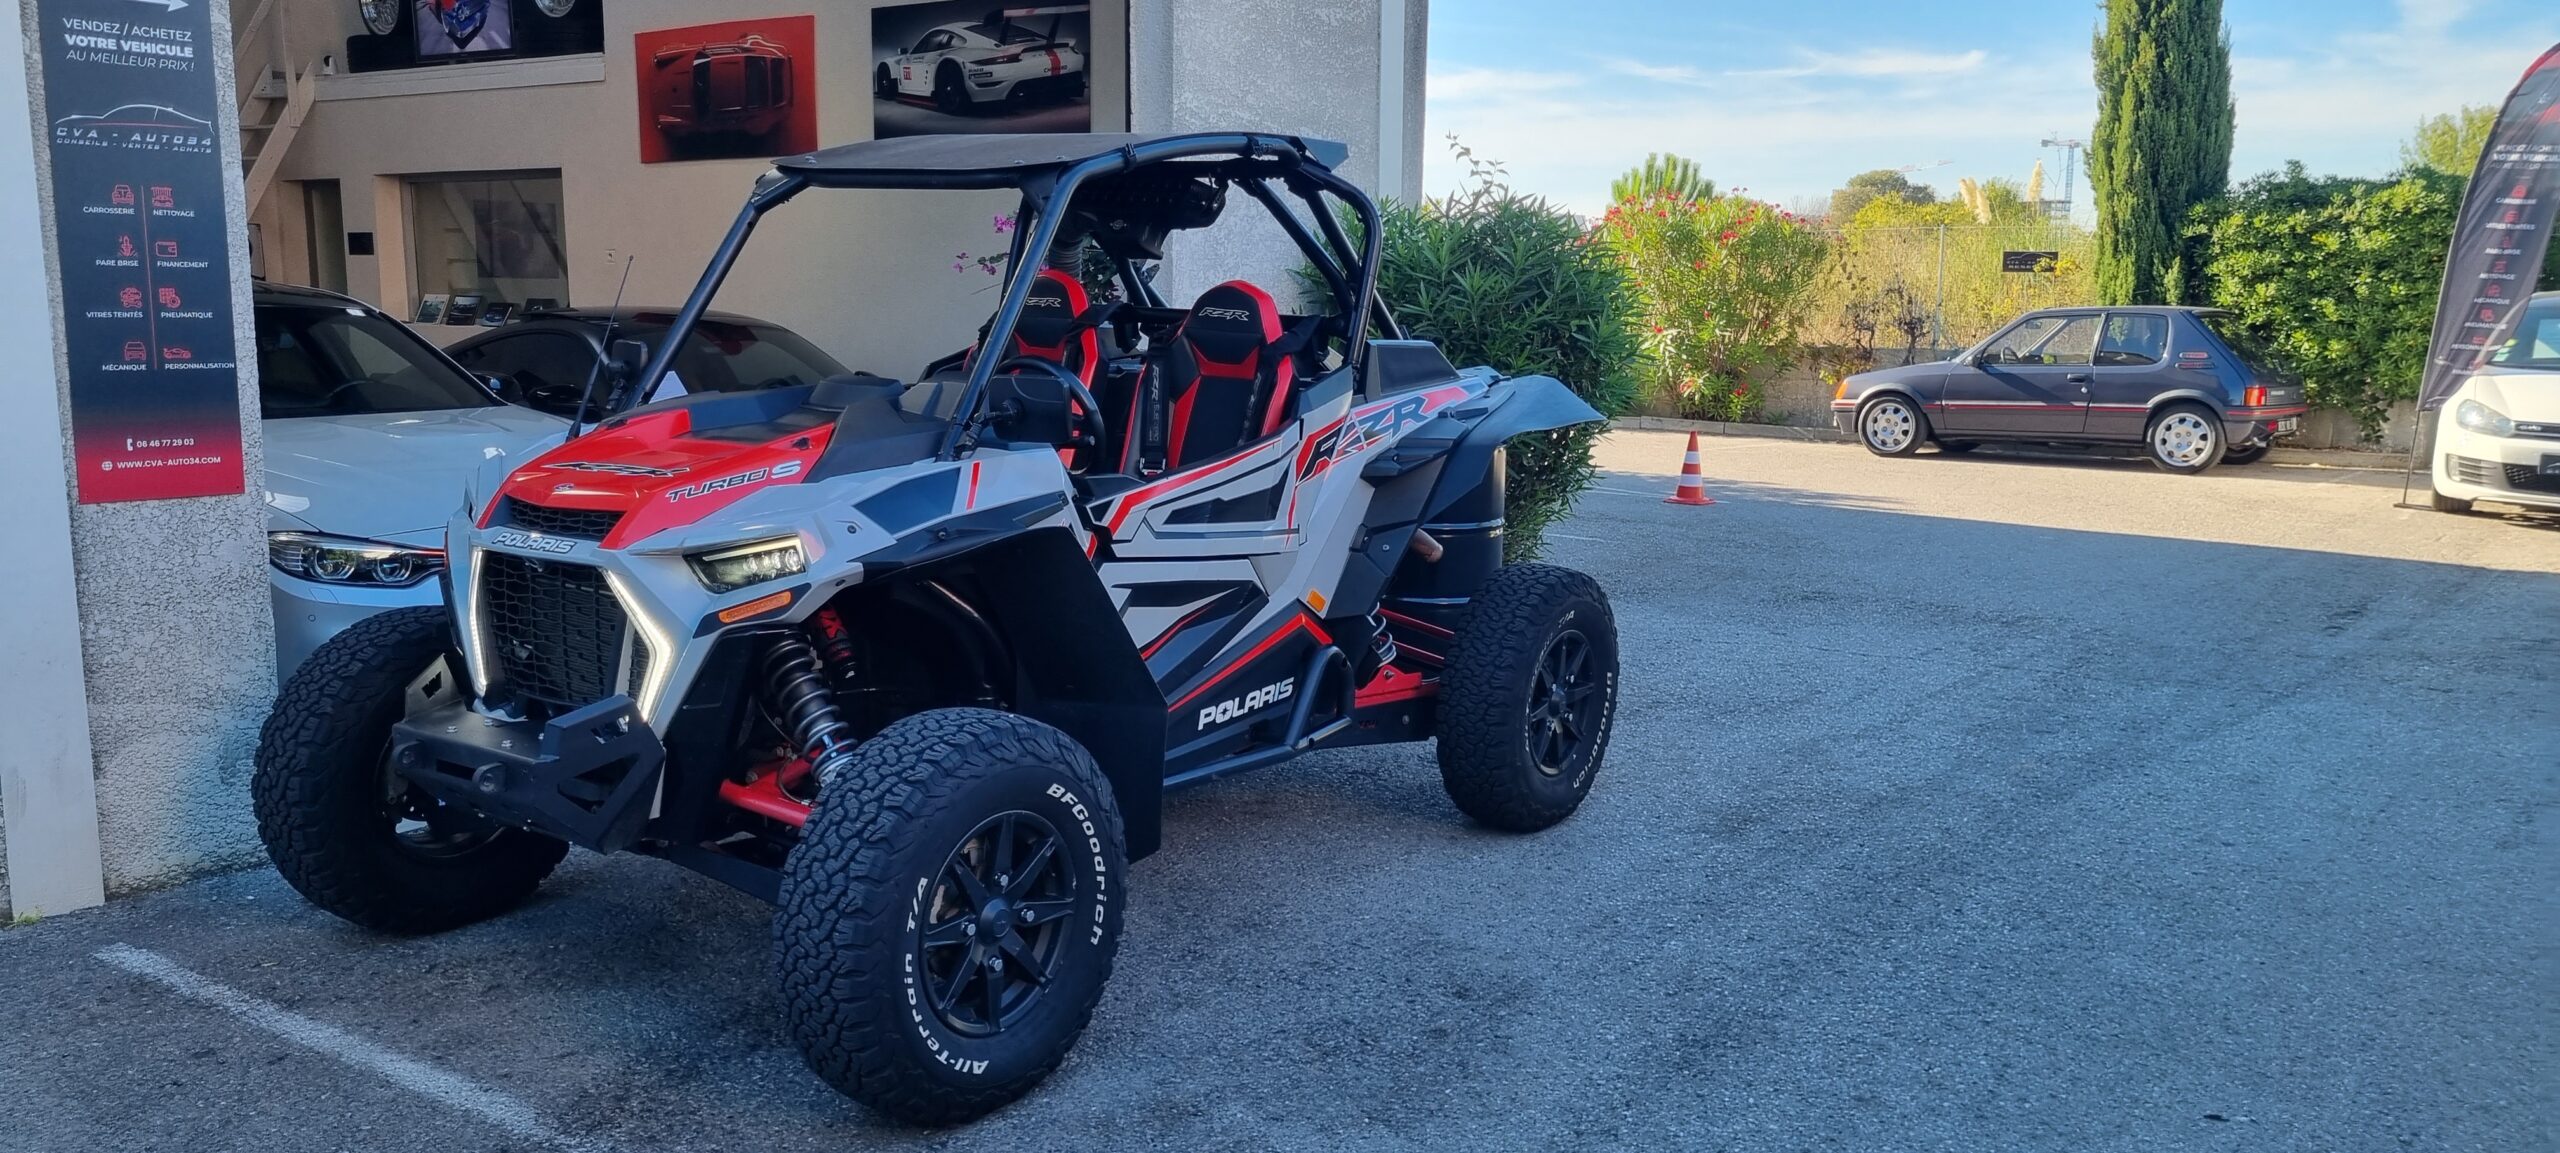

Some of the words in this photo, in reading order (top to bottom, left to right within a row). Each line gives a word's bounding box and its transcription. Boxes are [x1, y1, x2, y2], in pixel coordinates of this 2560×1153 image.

[62, 17, 121, 34] VENDEZ
[123, 22, 129, 36] /
[131, 25, 193, 42] ACHETEZ
[64, 33, 118, 50] VOTRE
[120, 39, 194, 58] VEHICULE
[66, 49, 87, 61] AU
[90, 51, 156, 68] MEILLEUR
[56, 127, 98, 138] CVA
[131, 132, 212, 146] AUTO34
[56, 137, 108, 147] CONSEILS
[122, 142, 160, 150] VENTES
[172, 146, 212, 154] ACHATS
[83, 206, 135, 215] CARROSSERIE
[153, 209, 195, 217] NETTOYAGE
[95, 259, 115, 267] PARE
[157, 261, 209, 269] FINANCEMENT
[86, 311, 111, 319] VITRES
[161, 311, 213, 319] PNEUMATIQUE
[165, 362, 235, 370] PERSONNALISATION
[136, 440, 148, 448] 06
[149, 440, 160, 448] 46
[161, 439, 172, 447] 77
[184, 438, 195, 446] 03
[117, 456, 221, 469] WWW.CVA-AUTO34.COM
[665, 467, 769, 503] TURBO
[771, 460, 802, 479] S
[491, 532, 578, 555] POLARIS
[1196, 676, 1296, 732] POLARIS
[1046, 782, 1107, 947] BFGoodrich
[906, 876, 929, 934] T/A
[904, 953, 990, 1076] All-Terrain
